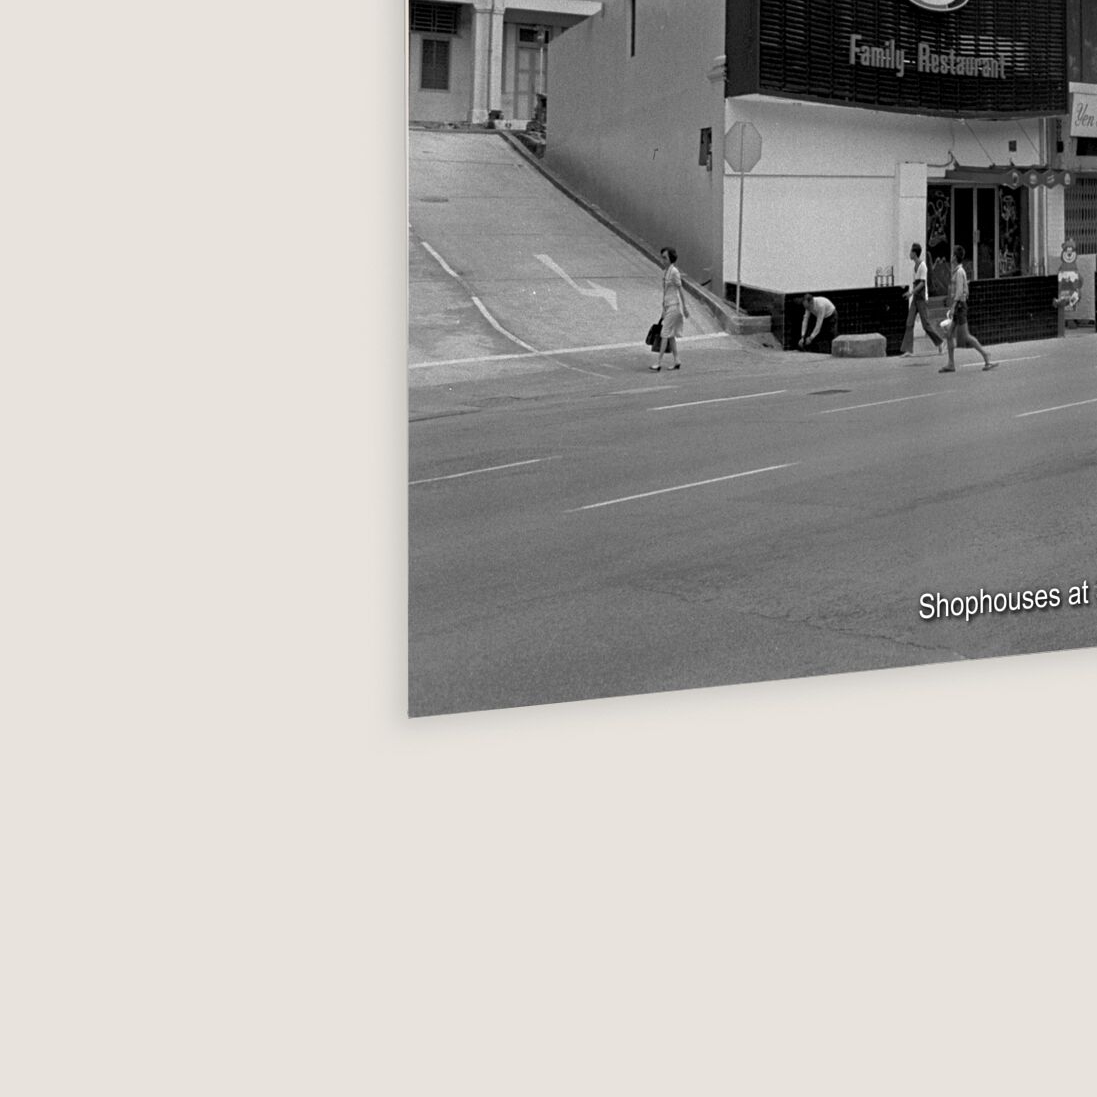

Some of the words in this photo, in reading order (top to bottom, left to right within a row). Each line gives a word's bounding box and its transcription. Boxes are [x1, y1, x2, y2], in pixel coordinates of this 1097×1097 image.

[849, 34, 905, 77] Family
[918, 41, 1006, 80] Restaurant
[1074, 102, 1094, 127] Yen
